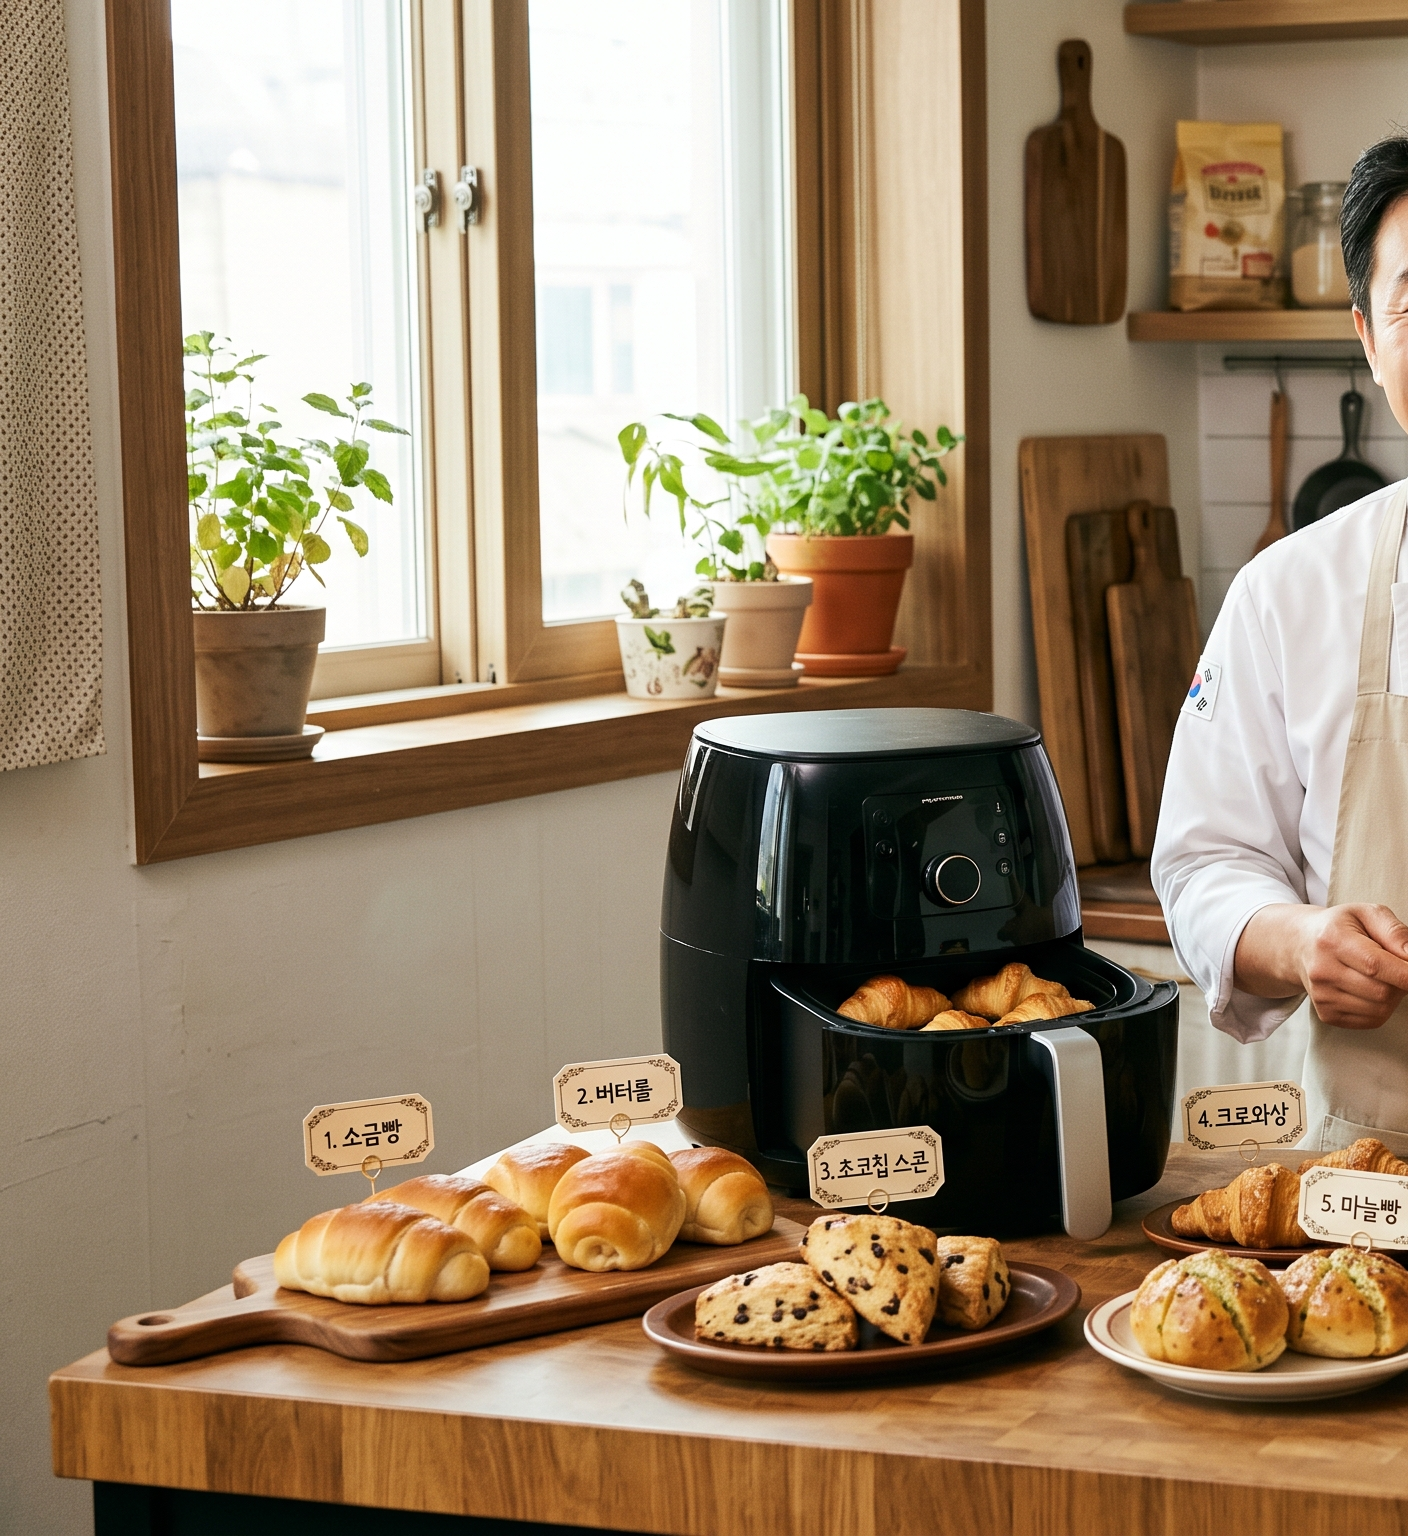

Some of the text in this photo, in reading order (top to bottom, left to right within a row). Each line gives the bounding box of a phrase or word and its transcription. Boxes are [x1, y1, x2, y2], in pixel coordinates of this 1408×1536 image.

[595, 1078, 653, 1104] 버터롤
[324, 1118, 403, 1150] 1. 소금빵
[837, 1153, 889, 1179] 초코칩
[892, 1150, 930, 1174] 스콘
[1320, 1193, 1402, 1225] 5. 마늘빵
